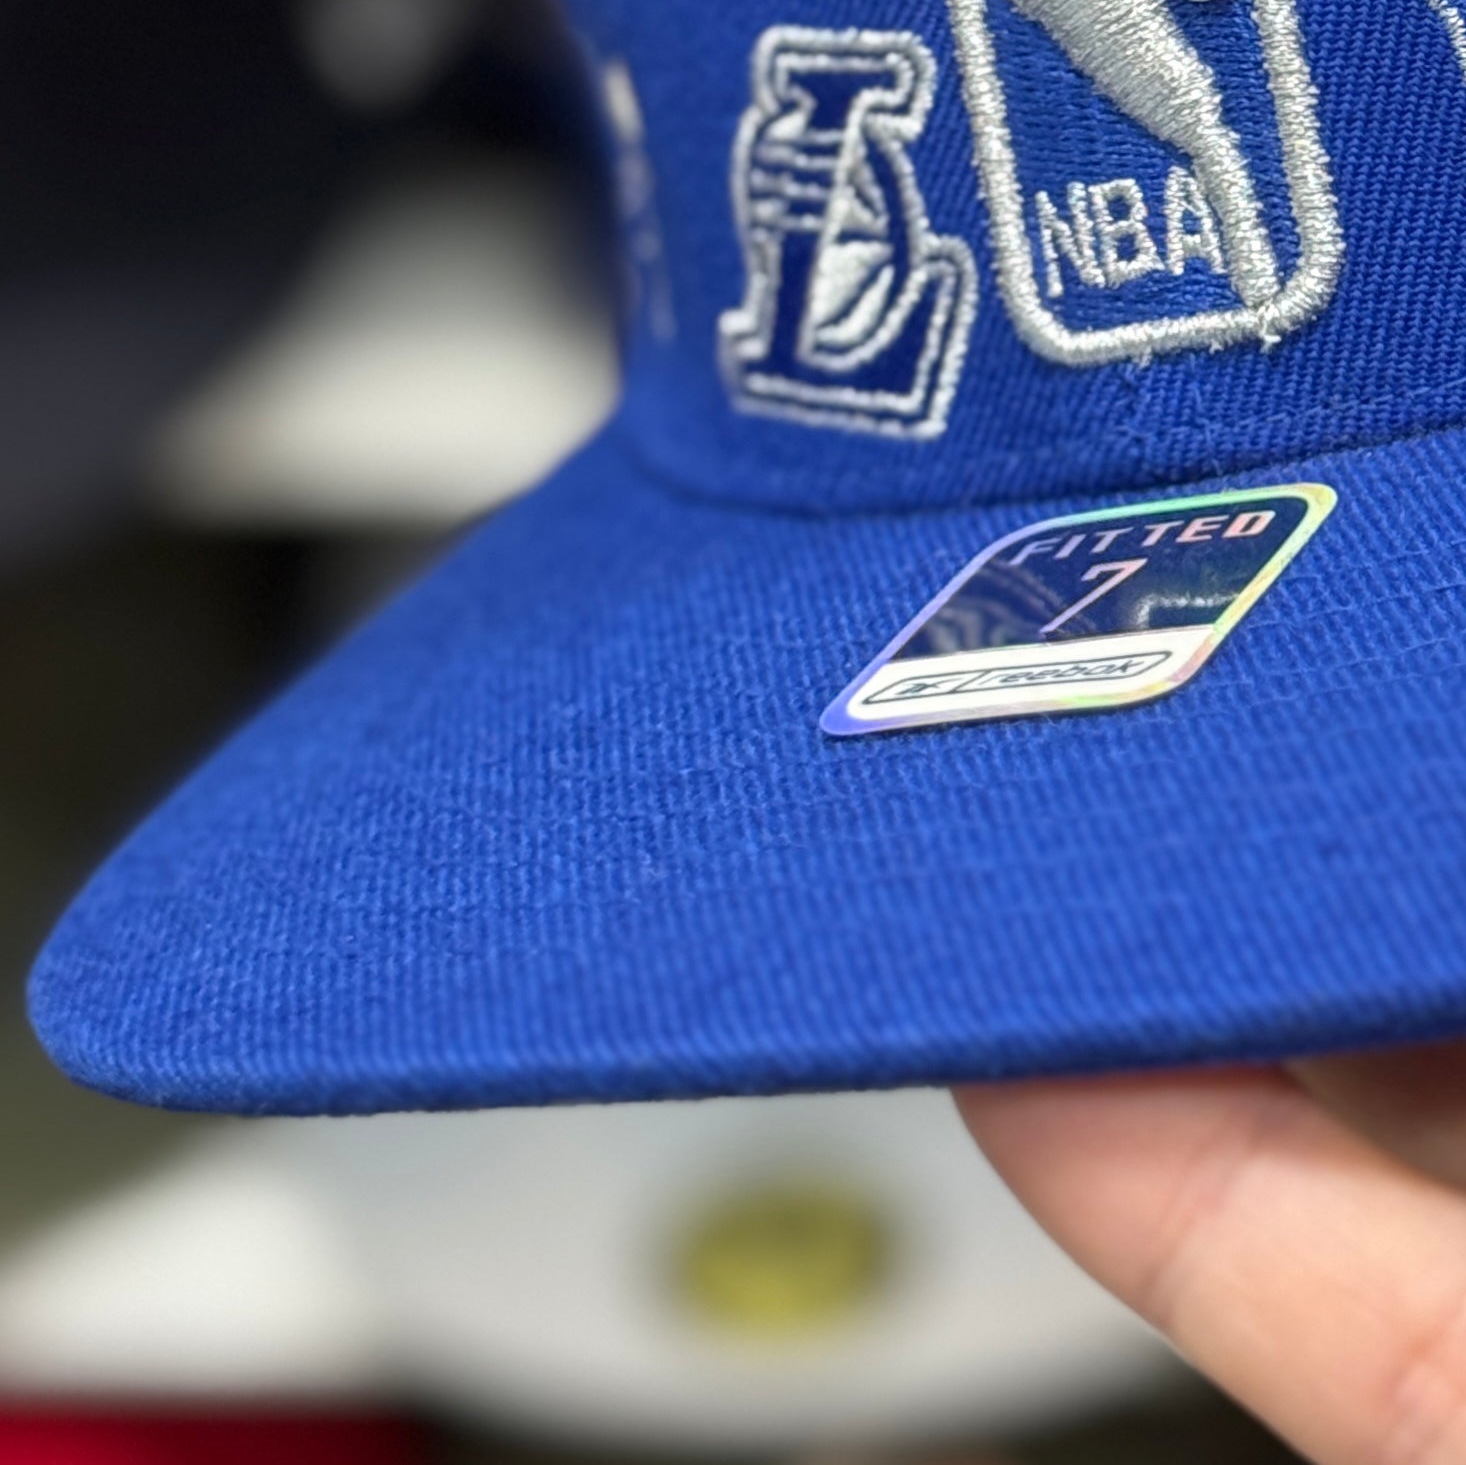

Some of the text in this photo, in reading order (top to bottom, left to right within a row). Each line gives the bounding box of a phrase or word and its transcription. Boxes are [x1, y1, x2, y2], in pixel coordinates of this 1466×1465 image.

[1035, 165, 1228, 298] NBA
[1008, 510, 1277, 566] FITTED
[1039, 558, 1149, 636] 7
